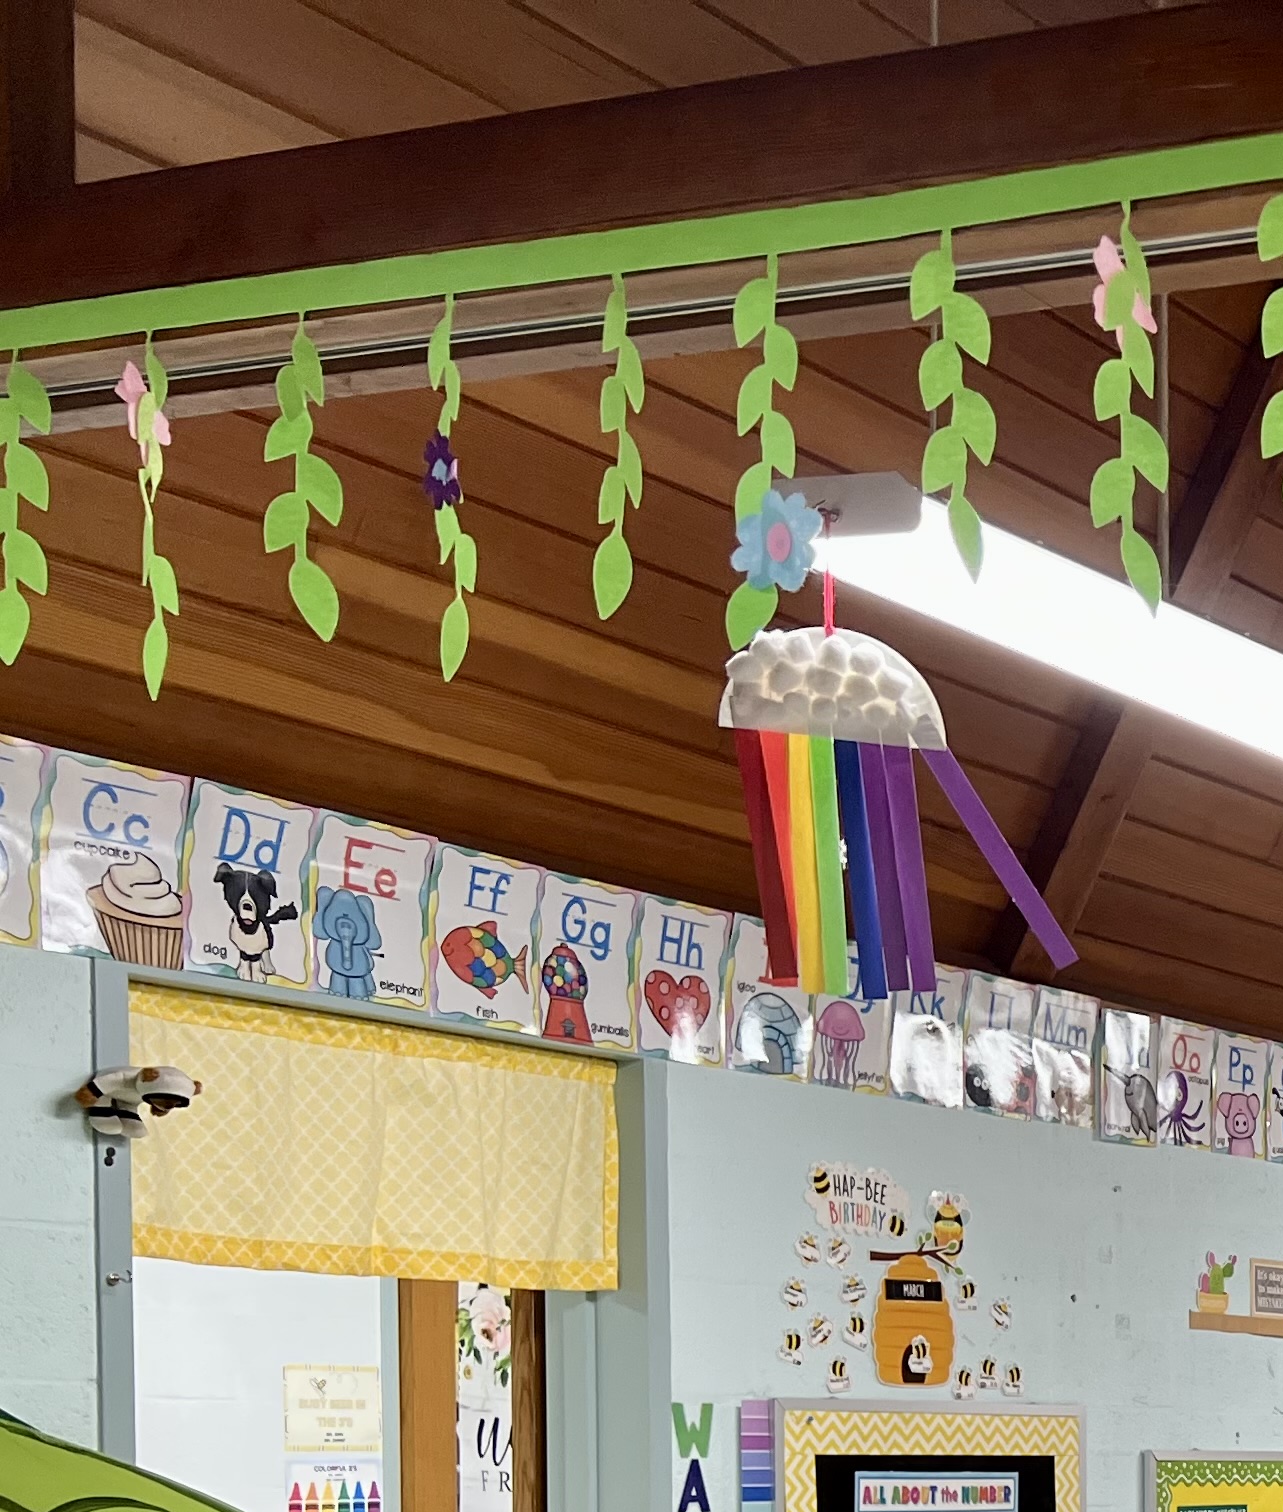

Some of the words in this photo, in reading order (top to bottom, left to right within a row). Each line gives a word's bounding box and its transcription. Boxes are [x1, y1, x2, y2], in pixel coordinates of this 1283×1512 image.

[83, 783, 150, 847] Cc
[74, 839, 131, 860] cupcake
[218, 807, 288, 873] Dd
[343, 837, 397, 899] Ee
[468, 866, 512, 913] Ff
[562, 896, 612, 961] Gg
[661, 915, 704, 970] Hh
[203, 942, 228, 959] dog
[380, 979, 424, 998] elephant
[737, 980, 756, 994] igloo
[476, 1005, 498, 1020] fish
[1044, 1007, 1088, 1049] Mm
[1172, 1034, 1201, 1073] Oo
[1229, 1046, 1254, 1092] Pp
[833, 1174, 887, 1205] HAP-BEE
[829, 1201, 886, 1232] BIRTHDAY
[903, 1284, 925, 1298] MARCH
[862, 1485, 887, 1505] ALL
[890, 1485, 938, 1506] ABOUT
[940, 1486, 959, 1504] the
[961, 1484, 1012, 1506] NUMBER
